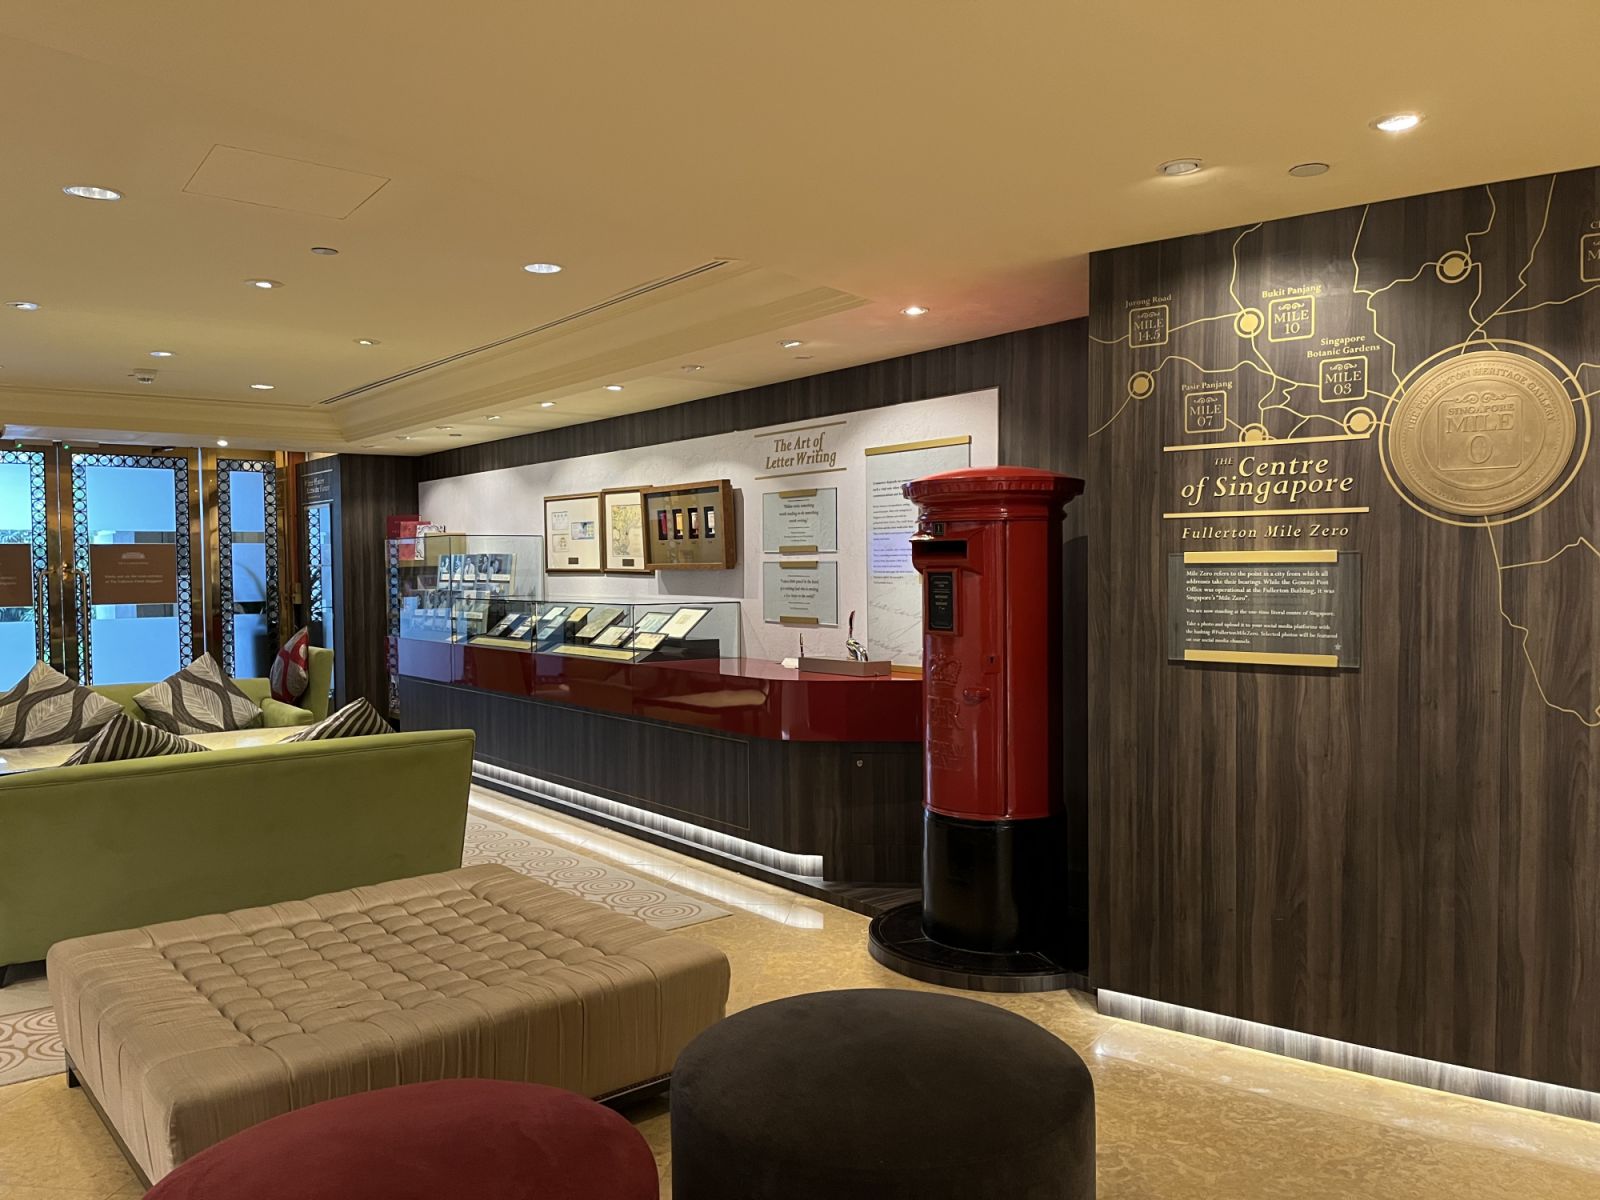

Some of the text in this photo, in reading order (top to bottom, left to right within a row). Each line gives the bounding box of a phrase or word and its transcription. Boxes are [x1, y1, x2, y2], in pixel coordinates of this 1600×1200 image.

[1262, 284, 1322, 299] Bukit Panjang
[1125, 294, 1172, 309] Jurong Road
[1274, 309, 1310, 324] MILE
[1134, 318, 1165, 331] MILE
[1284, 322, 1301, 335] 10
[1139, 329, 1161, 342] 14.5
[1320, 335, 1366, 348] Singapore
[1307, 344, 1381, 359] Botanic Gardens
[1325, 370, 1362, 384] MILE
[1181, 379, 1233, 392] Pasir Panjang
[1333, 383, 1352, 396] 03
[1473, 367, 1527, 385] HERITAGE
[1529, 382, 1556, 423] GALLERY
[1189, 404, 1223, 416] MILE
[1448, 403, 1515, 416] SINGAPORE
[1197, 416, 1214, 427] 07
[1446, 413, 1515, 434] MILE
[774, 431, 825, 453] The Art of
[766, 450, 836, 469] Letter Writing
[1215, 456, 1329, 477] THE Centre
[1181, 475, 1354, 506] of Singapore
[1182, 523, 1349, 539] Fullerton Mile Zero
[1247, 570, 1262, 579] point
[1275, 570, 1285, 578] city
[1215, 586, 1245, 594] operational
